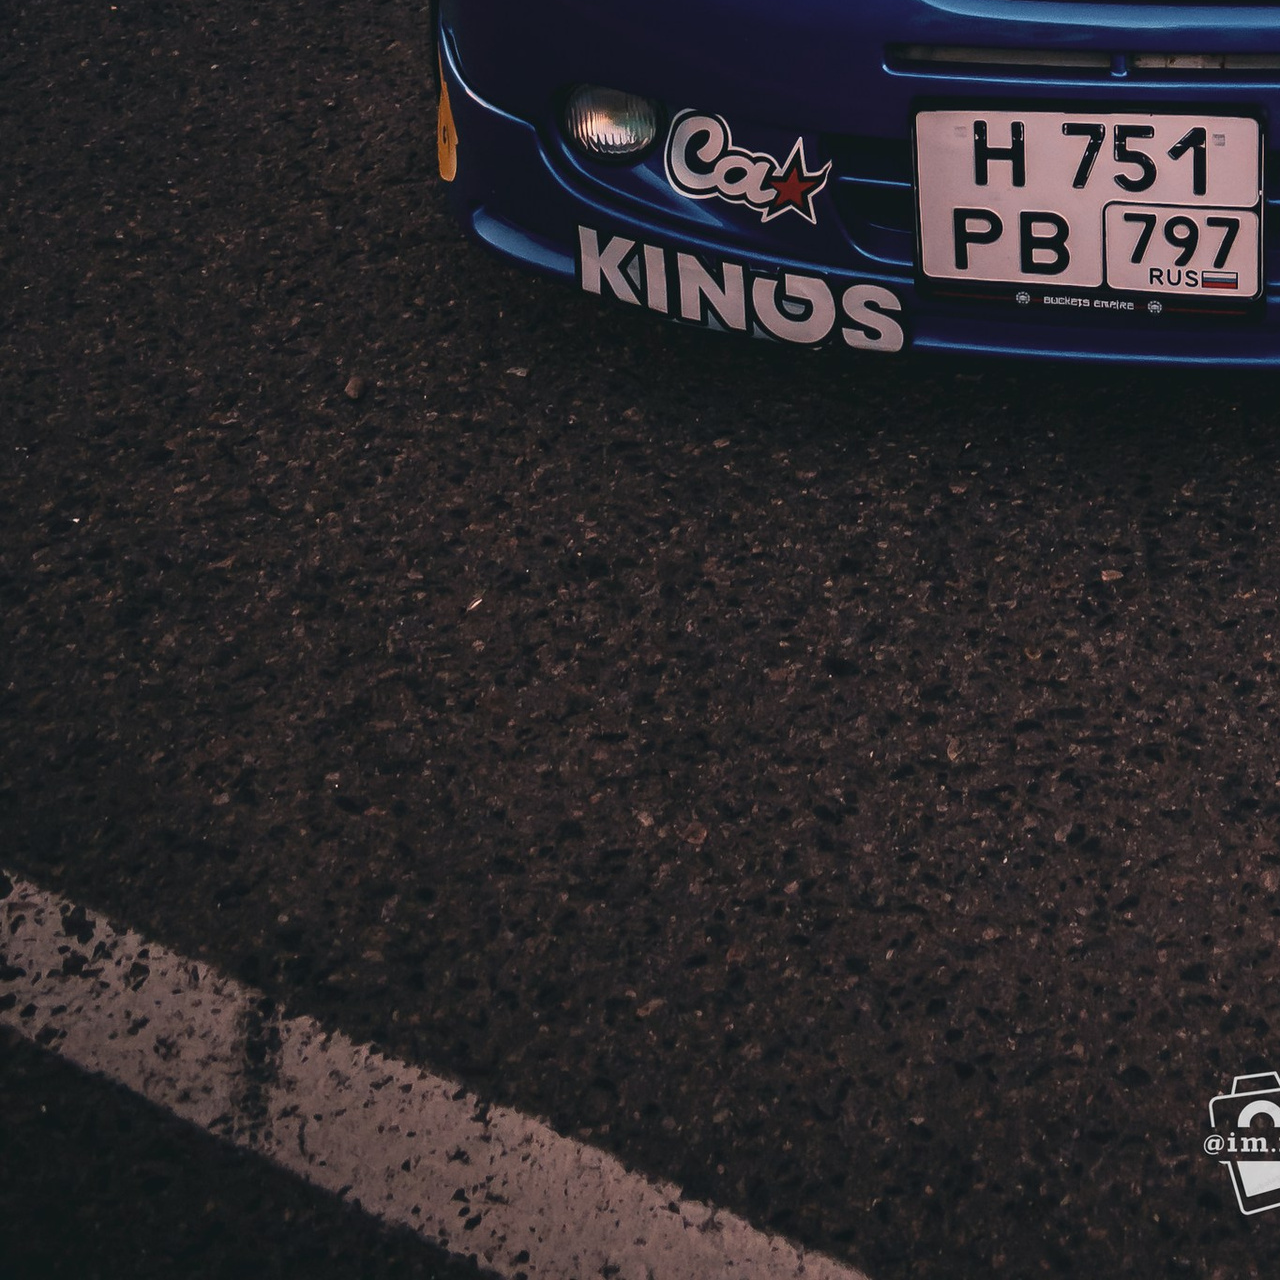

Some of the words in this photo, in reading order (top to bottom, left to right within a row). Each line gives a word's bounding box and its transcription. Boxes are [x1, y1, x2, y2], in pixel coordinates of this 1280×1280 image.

[1062, 123, 1206, 196] 751
[1123, 213, 1239, 268] 797
[578, 225, 904, 352] KINGS
[1149, 268, 1199, 287] RUS
